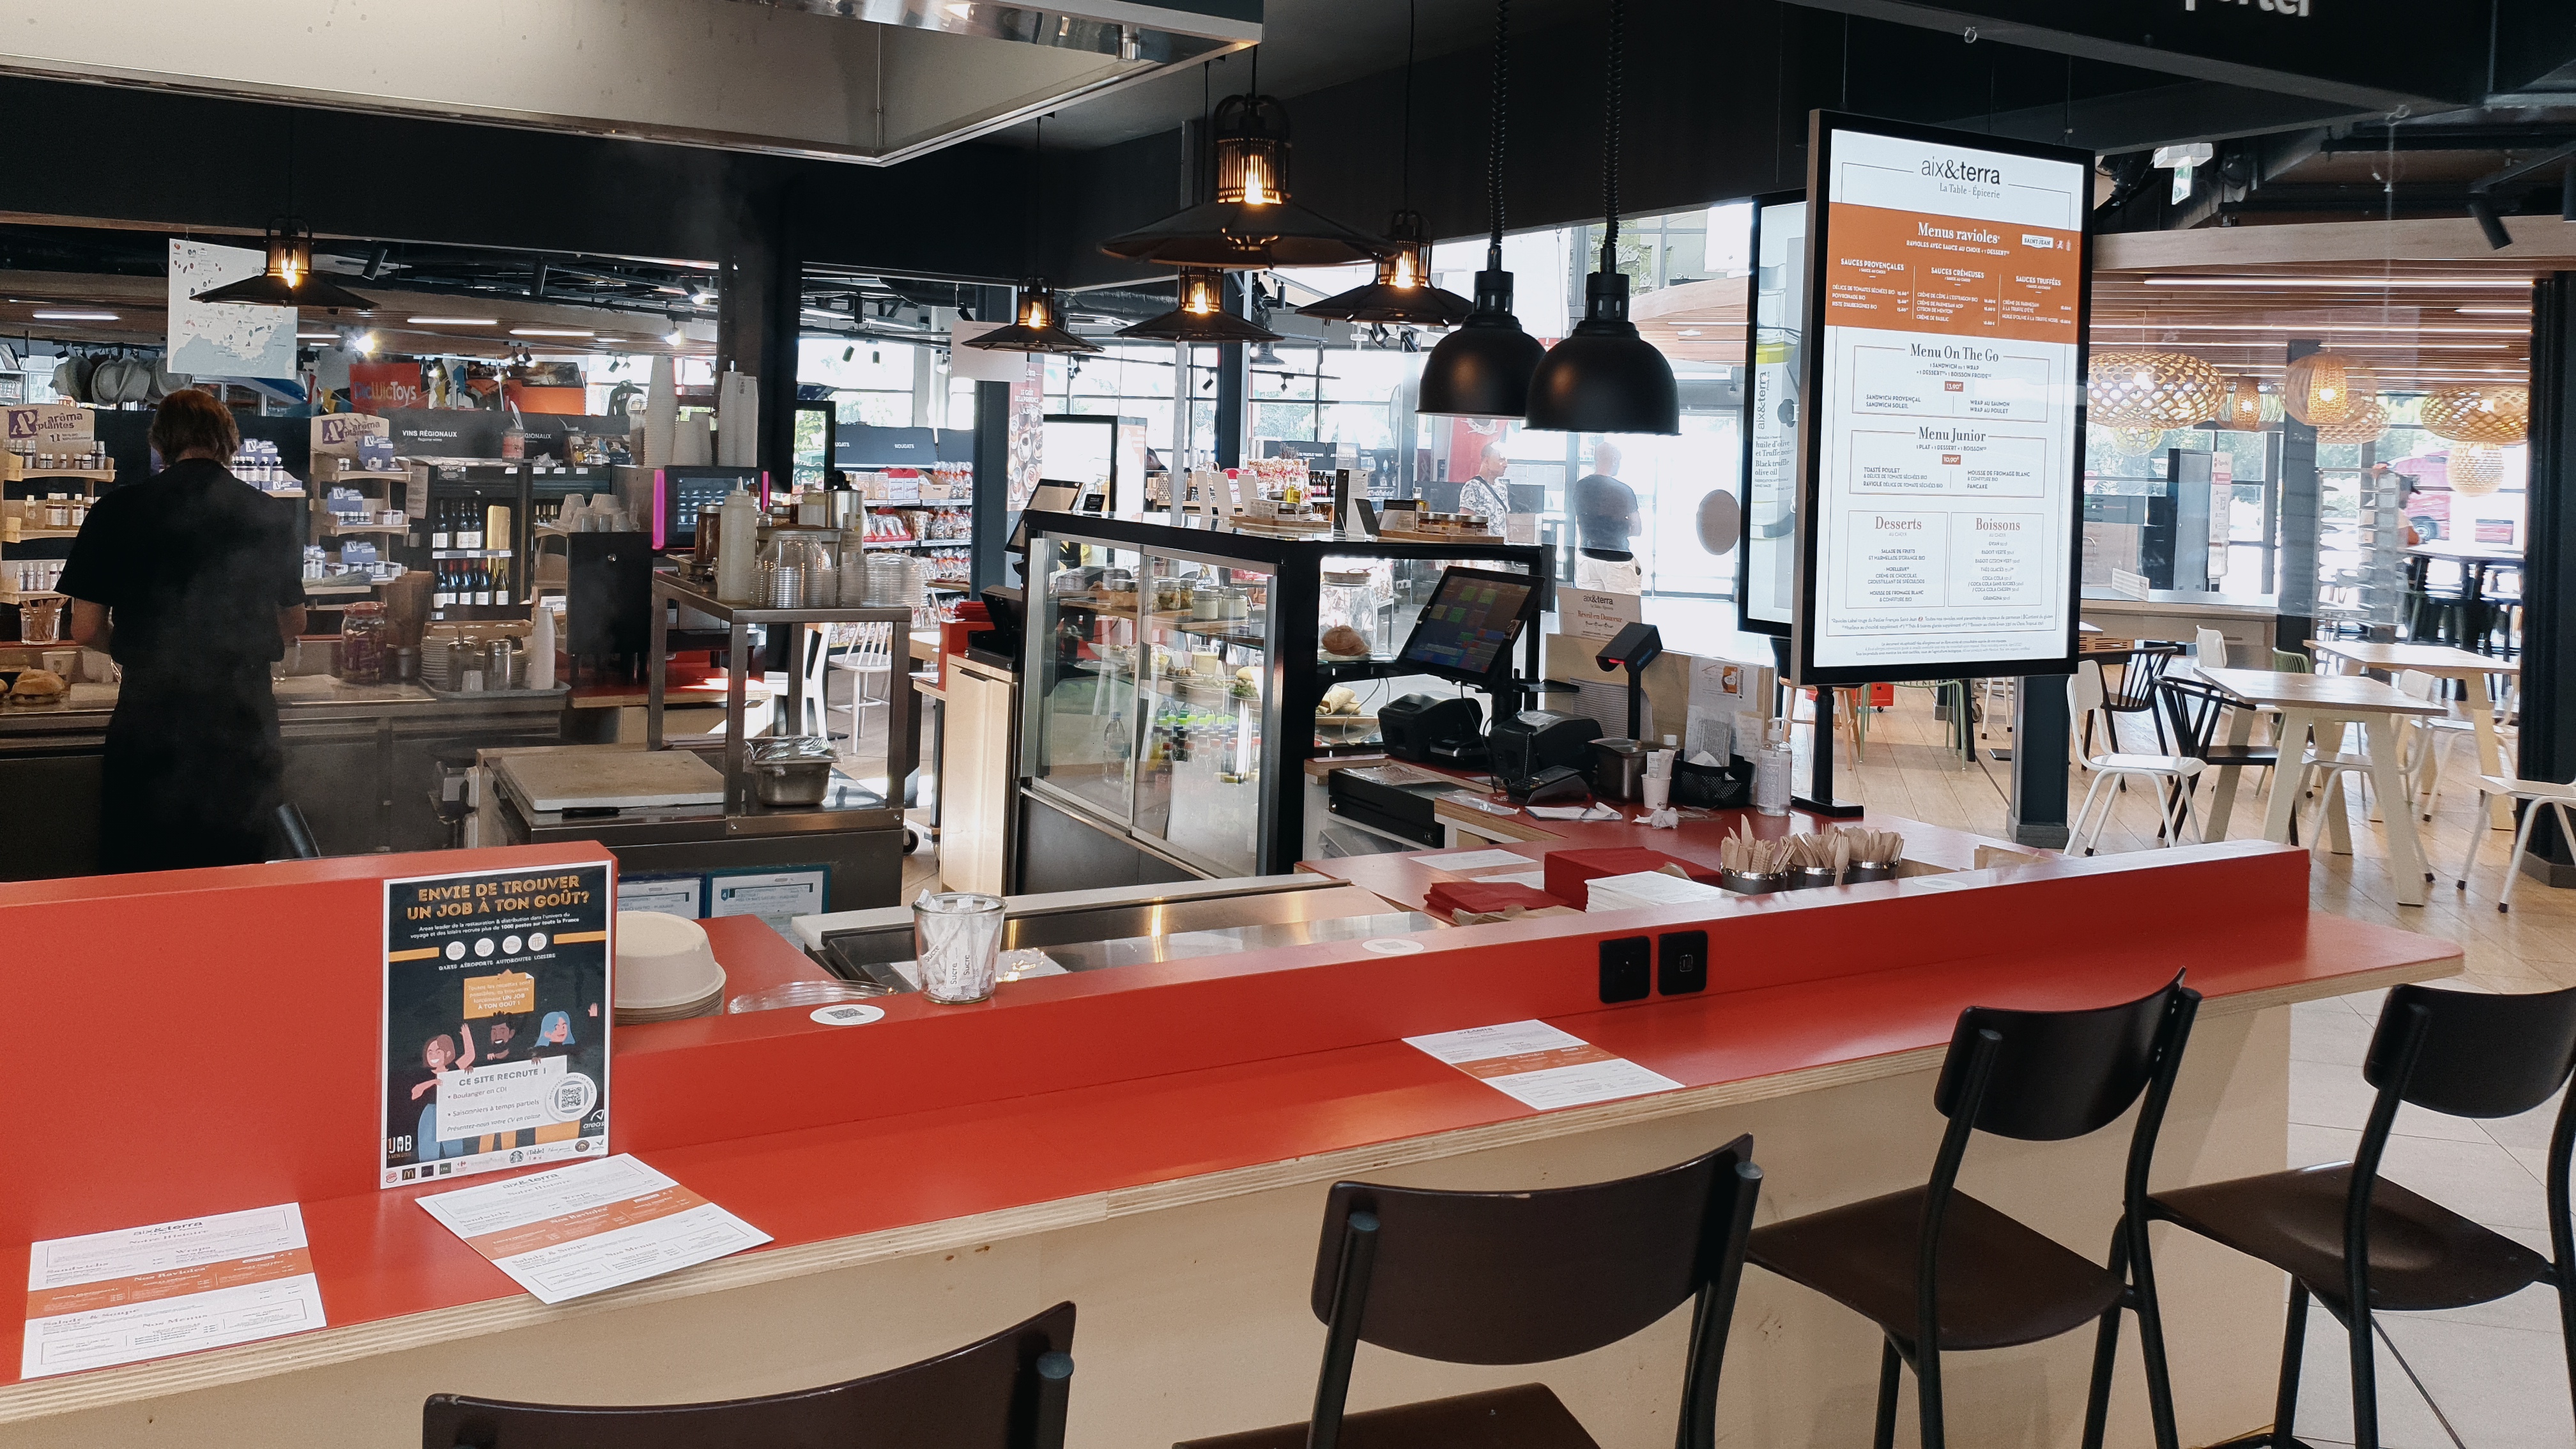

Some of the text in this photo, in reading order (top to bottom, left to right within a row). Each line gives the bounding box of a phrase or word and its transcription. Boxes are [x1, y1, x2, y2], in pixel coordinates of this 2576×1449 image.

[1922, 156, 2000, 185] aix&terra
[1940, 183, 2000, 199] La Table Épicerie
[1918, 221, 1954, 239] Menus
[1906, 240, 1929, 249] RAVIOLES
[1929, 242, 1942, 250] AVEC
[1943, 243, 1958, 252] SAUCE
[2024, 237, 2051, 247] SAINT-JEAN
[1841, 257, 1905, 272] SAUCES PROVENÇALES
[1931, 266, 1984, 279] SAUCES CRÉMEUSES
[2016, 275, 2062, 286] SAUCES TRUFFÉES
[1910, 342, 1999, 363] Menu On The Go
[1933, 362, 1958, 371] SANDWICH
[1756, 371, 1767, 430] aix&terra
[1892, 395, 1921, 404] PROVENÇAL
[47, 412, 83, 423] arôma
[38, 419, 75, 431] plantes
[419, 429, 457, 438] RÉGIONAUX
[1919, 426, 1986, 443] Menu Junior
[1772, 440, 1790, 448] d'olive
[1875, 516, 1922, 531] Desserts
[1975, 518, 2020, 532] Boissons
[1583, 594, 1614, 606] aix&terra
[1577, 610, 1593, 619] Réveil
[418, 875, 580, 902] ENVIE DE TROUVER
[406, 889, 590, 921] UN JOB À TON GOÛT?
[465, 919, 495, 928] restauration
[501, 916, 530, 924] distribution
[410, 931, 429, 940] voyage
[462, 926, 480, 935] recrute
[481, 925, 493, 934] plus
[514, 921, 533, 930] postes
[924, 945, 940, 962] Sucre
[438, 953, 556, 972] GARES AÉROPORTS AUTOROUTES LOISIRS
[459, 1069, 539, 1087] CE SITE RECRUTE
[452, 1090, 486, 1100] Boulanger
[452, 1107, 489, 1117] Saisonniers
[496, 1103, 515, 1112] temps
[516, 1100, 540, 1109] partiels
[447, 1121, 490, 1133] Présentez-nous
[525, 1113, 541, 1121] caisse
[583, 1121, 604, 1130] areas
[502, 1172, 560, 1191] aix&terra
[549, 1216, 569, 1225] Nos
[133, 1220, 204, 1237] aix&terra
[133, 1273, 156, 1283] Nos
